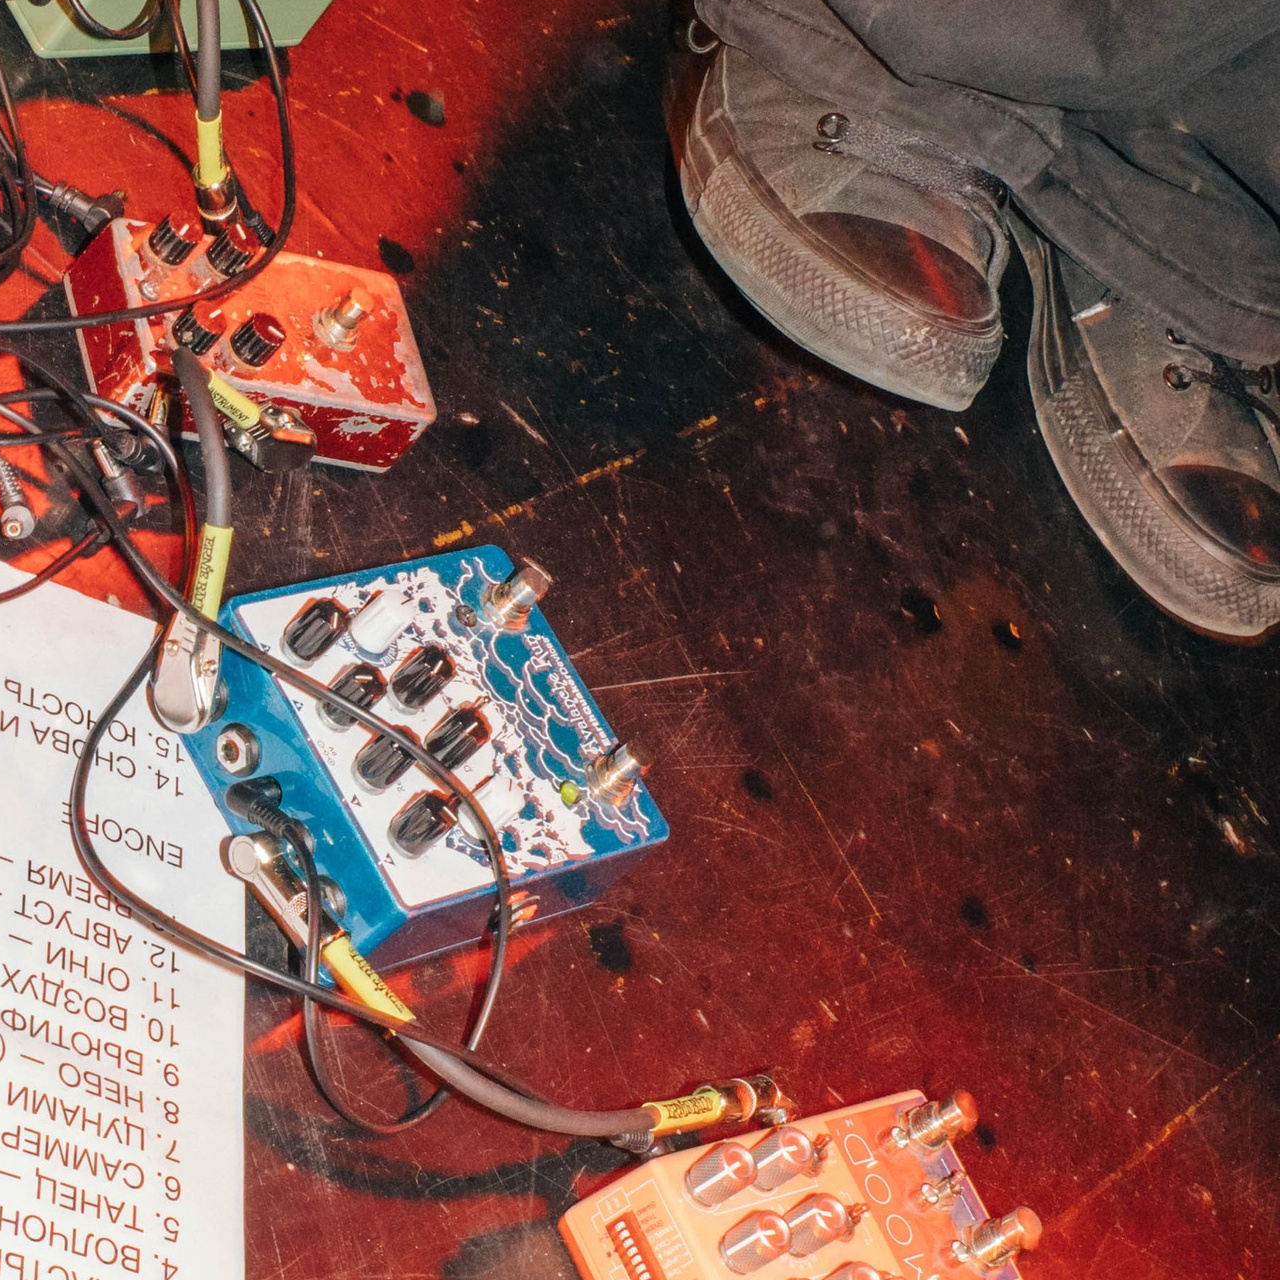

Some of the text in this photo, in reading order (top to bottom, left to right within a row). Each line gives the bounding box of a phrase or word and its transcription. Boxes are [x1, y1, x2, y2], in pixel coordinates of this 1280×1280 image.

[524, 634, 604, 755] Avalanche Run
[0, 710, 19, 737] И
[148, 733, 184, 763] 15.
[148, 766, 184, 797] 14.
[14, 894, 132, 954] АВГУСТ
[47, 942, 130, 992] ОГНИ
[143, 940, 180, 973] 12.
[0, 964, 127, 1031] ВОЗДУХ
[142, 977, 180, 1009] 11.
[141, 1014, 179, 1047] 10.
[59, 1063, 143, 1113] НЕБО
[156, 1059, 179, 1087] 9.
[8, 1082, 144, 1151] ЦУНАМИ
[156, 1097, 179, 1124] 8.
[157, 1134, 180, 1163] 7.
[36, 1168, 144, 1232] ТАНЕЦ
[157, 1172, 181, 1201] 6.
[156, 1213, 179, 1243] 5.
